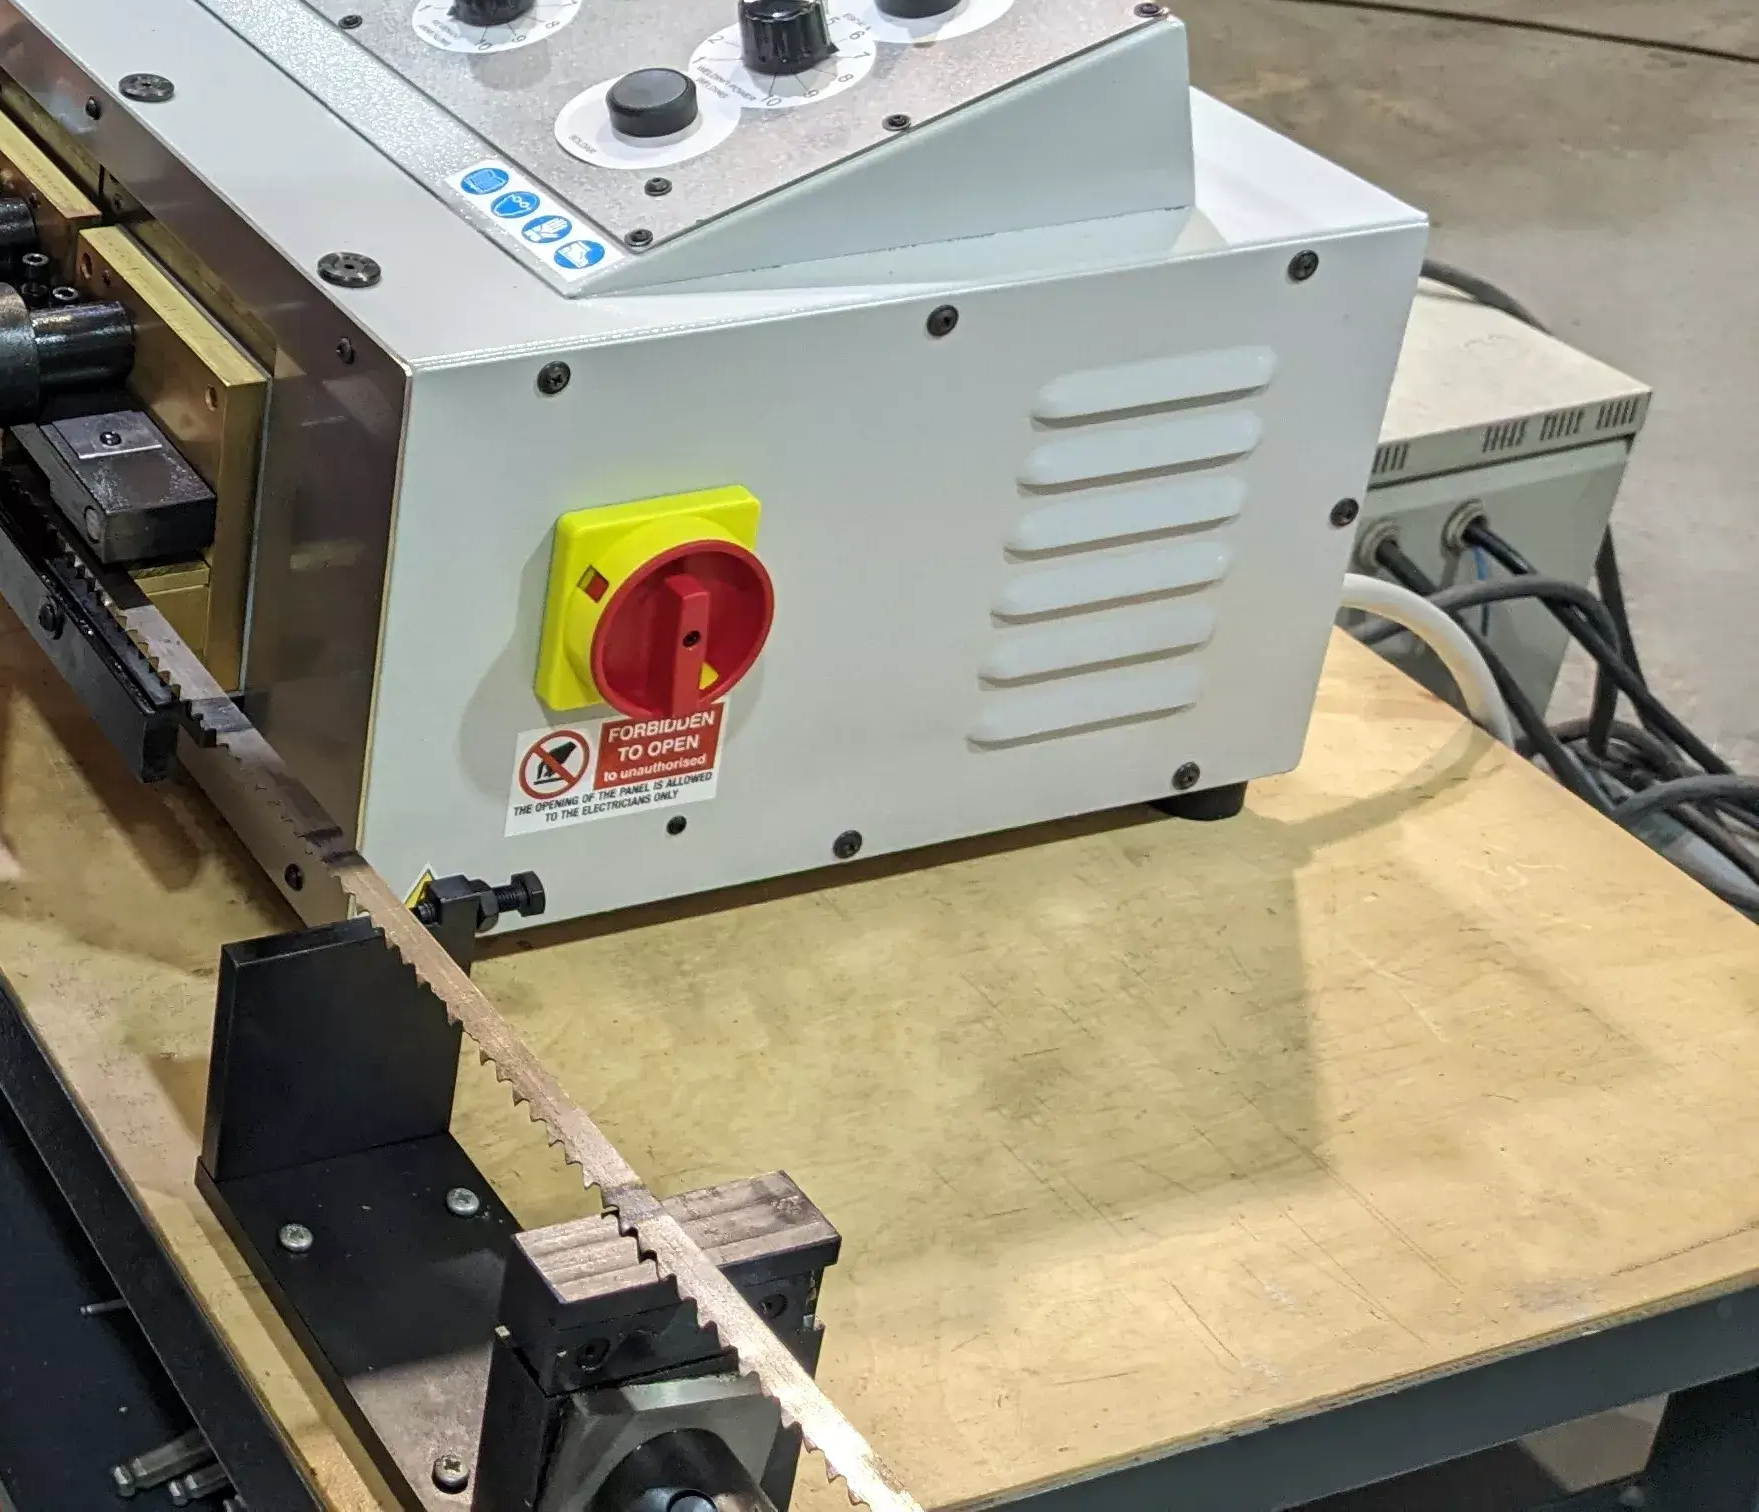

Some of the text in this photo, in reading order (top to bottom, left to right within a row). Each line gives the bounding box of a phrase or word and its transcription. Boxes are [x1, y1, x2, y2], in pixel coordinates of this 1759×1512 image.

[608, 710, 715, 743] FORBIDDEN
[618, 735, 700, 762] TO OPEN
[603, 754, 707, 782] to unauthorised
[514, 771, 713, 817] THE OPENING OF THE PANEL IS ALLOWED
[545, 788, 680, 823] TO THE ELECTRICIANS ONLY
